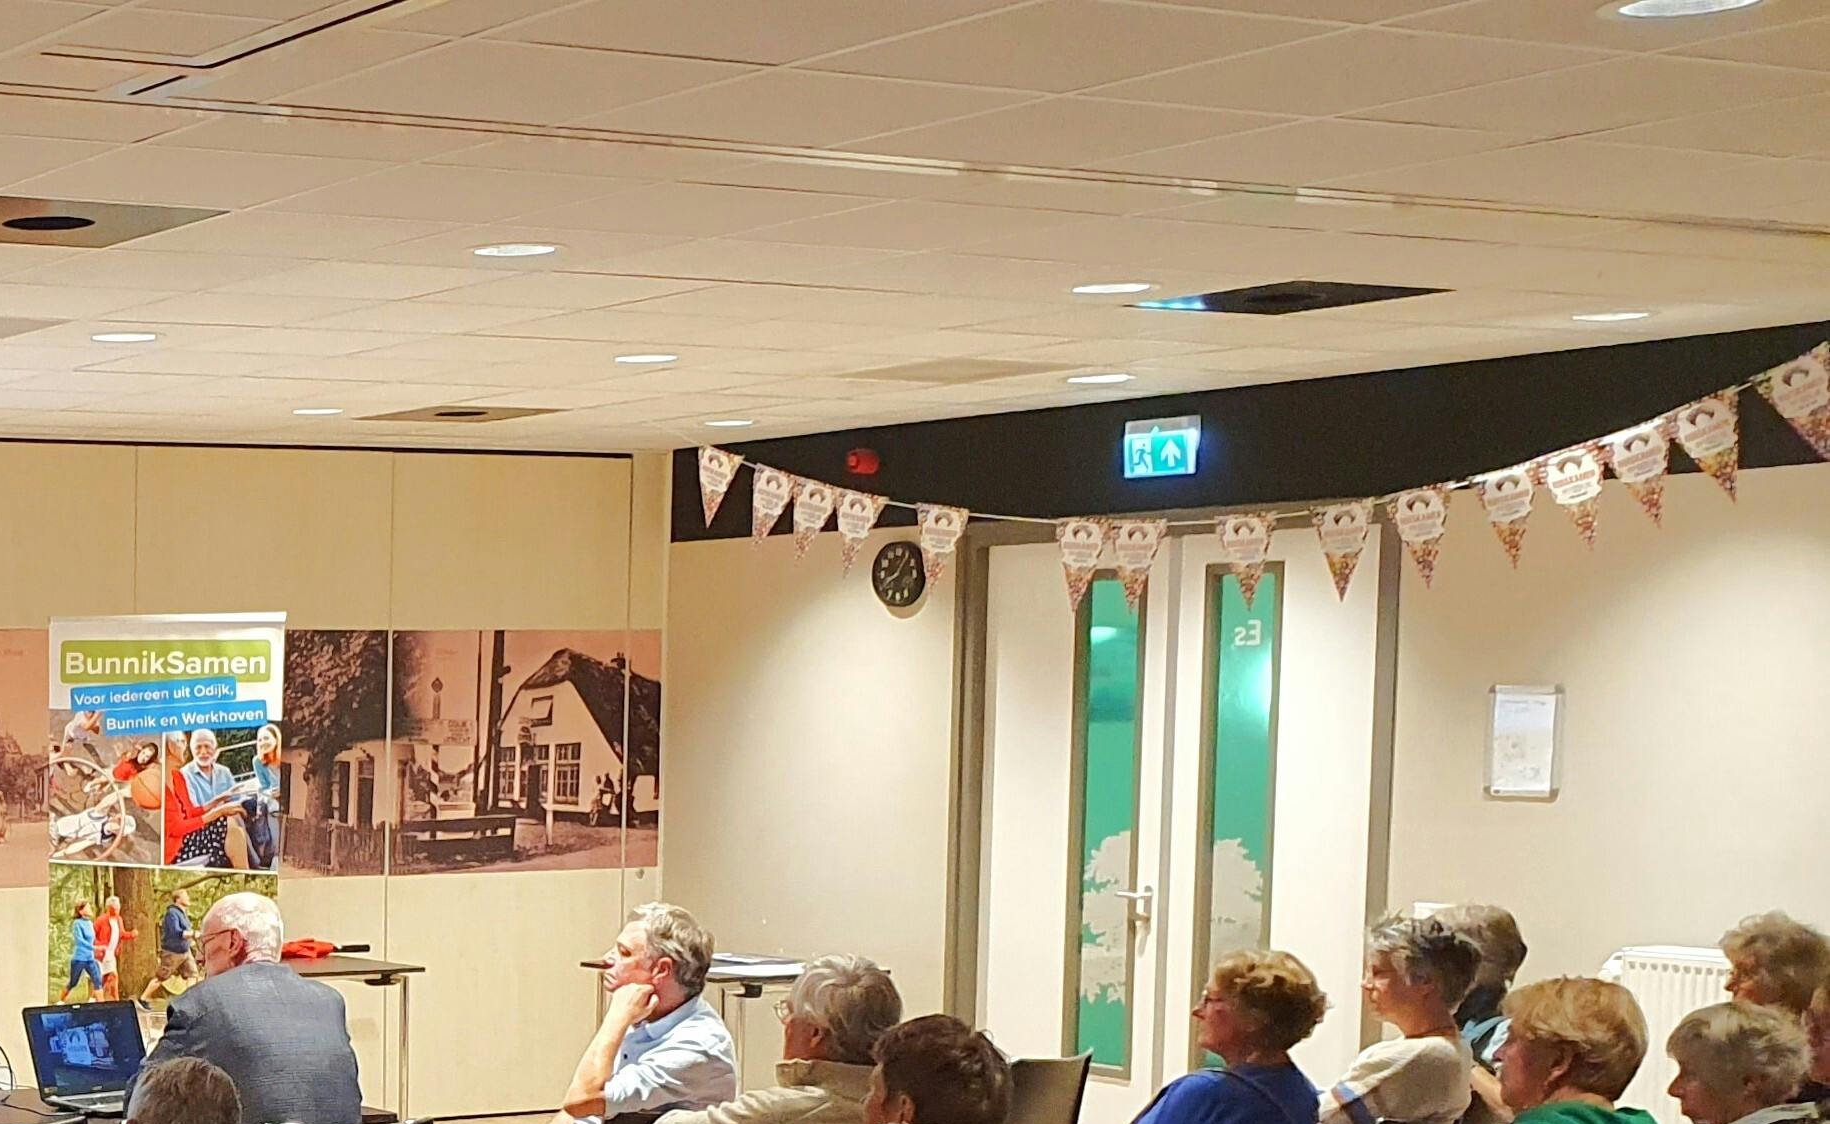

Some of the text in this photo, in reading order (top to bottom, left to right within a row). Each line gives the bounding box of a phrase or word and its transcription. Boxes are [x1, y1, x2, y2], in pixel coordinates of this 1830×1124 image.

[1233, 619, 1262, 646] 23
[64, 650, 267, 675] BunnikSamen
[74, 693, 105, 706] Voor
[109, 690, 170, 705] iedereen
[173, 686, 191, 699] uit
[106, 709, 265, 731] Bunnik en Werkhoven
